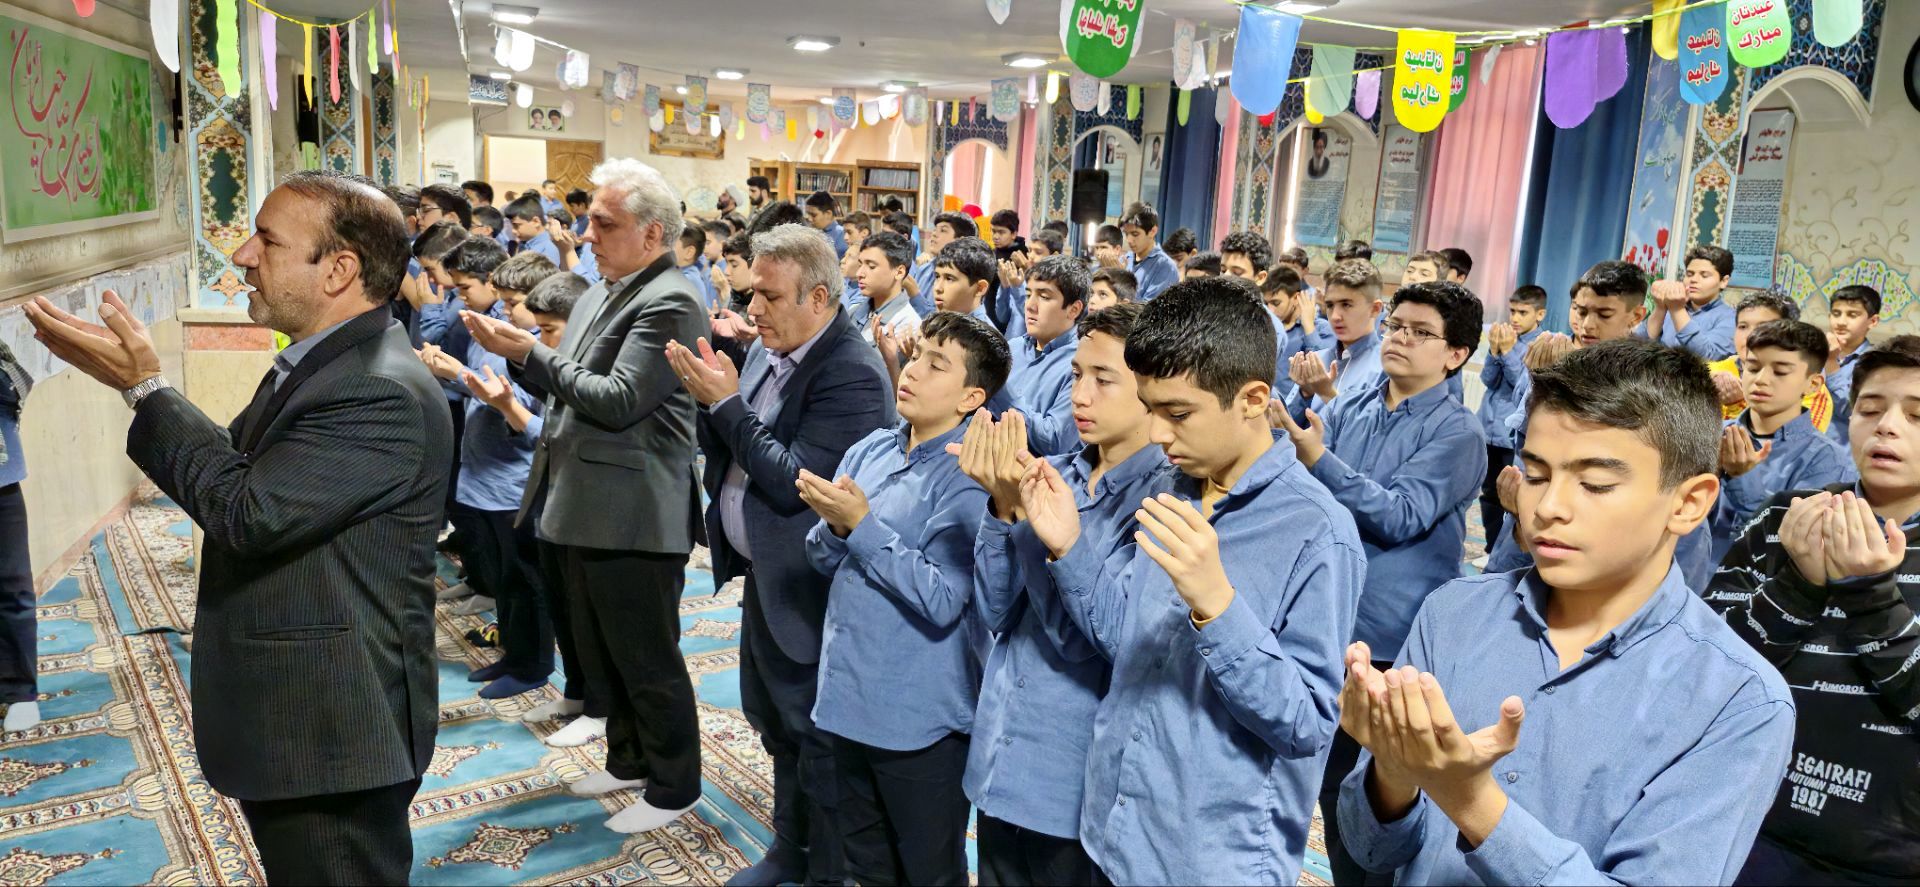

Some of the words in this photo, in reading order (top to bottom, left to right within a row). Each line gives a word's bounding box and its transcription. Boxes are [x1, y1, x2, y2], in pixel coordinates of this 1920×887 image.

[1788, 770, 1827, 791] AUTUMN
[1827, 783, 1867, 803] BREEZE
[1791, 785, 1828, 810] 1987
